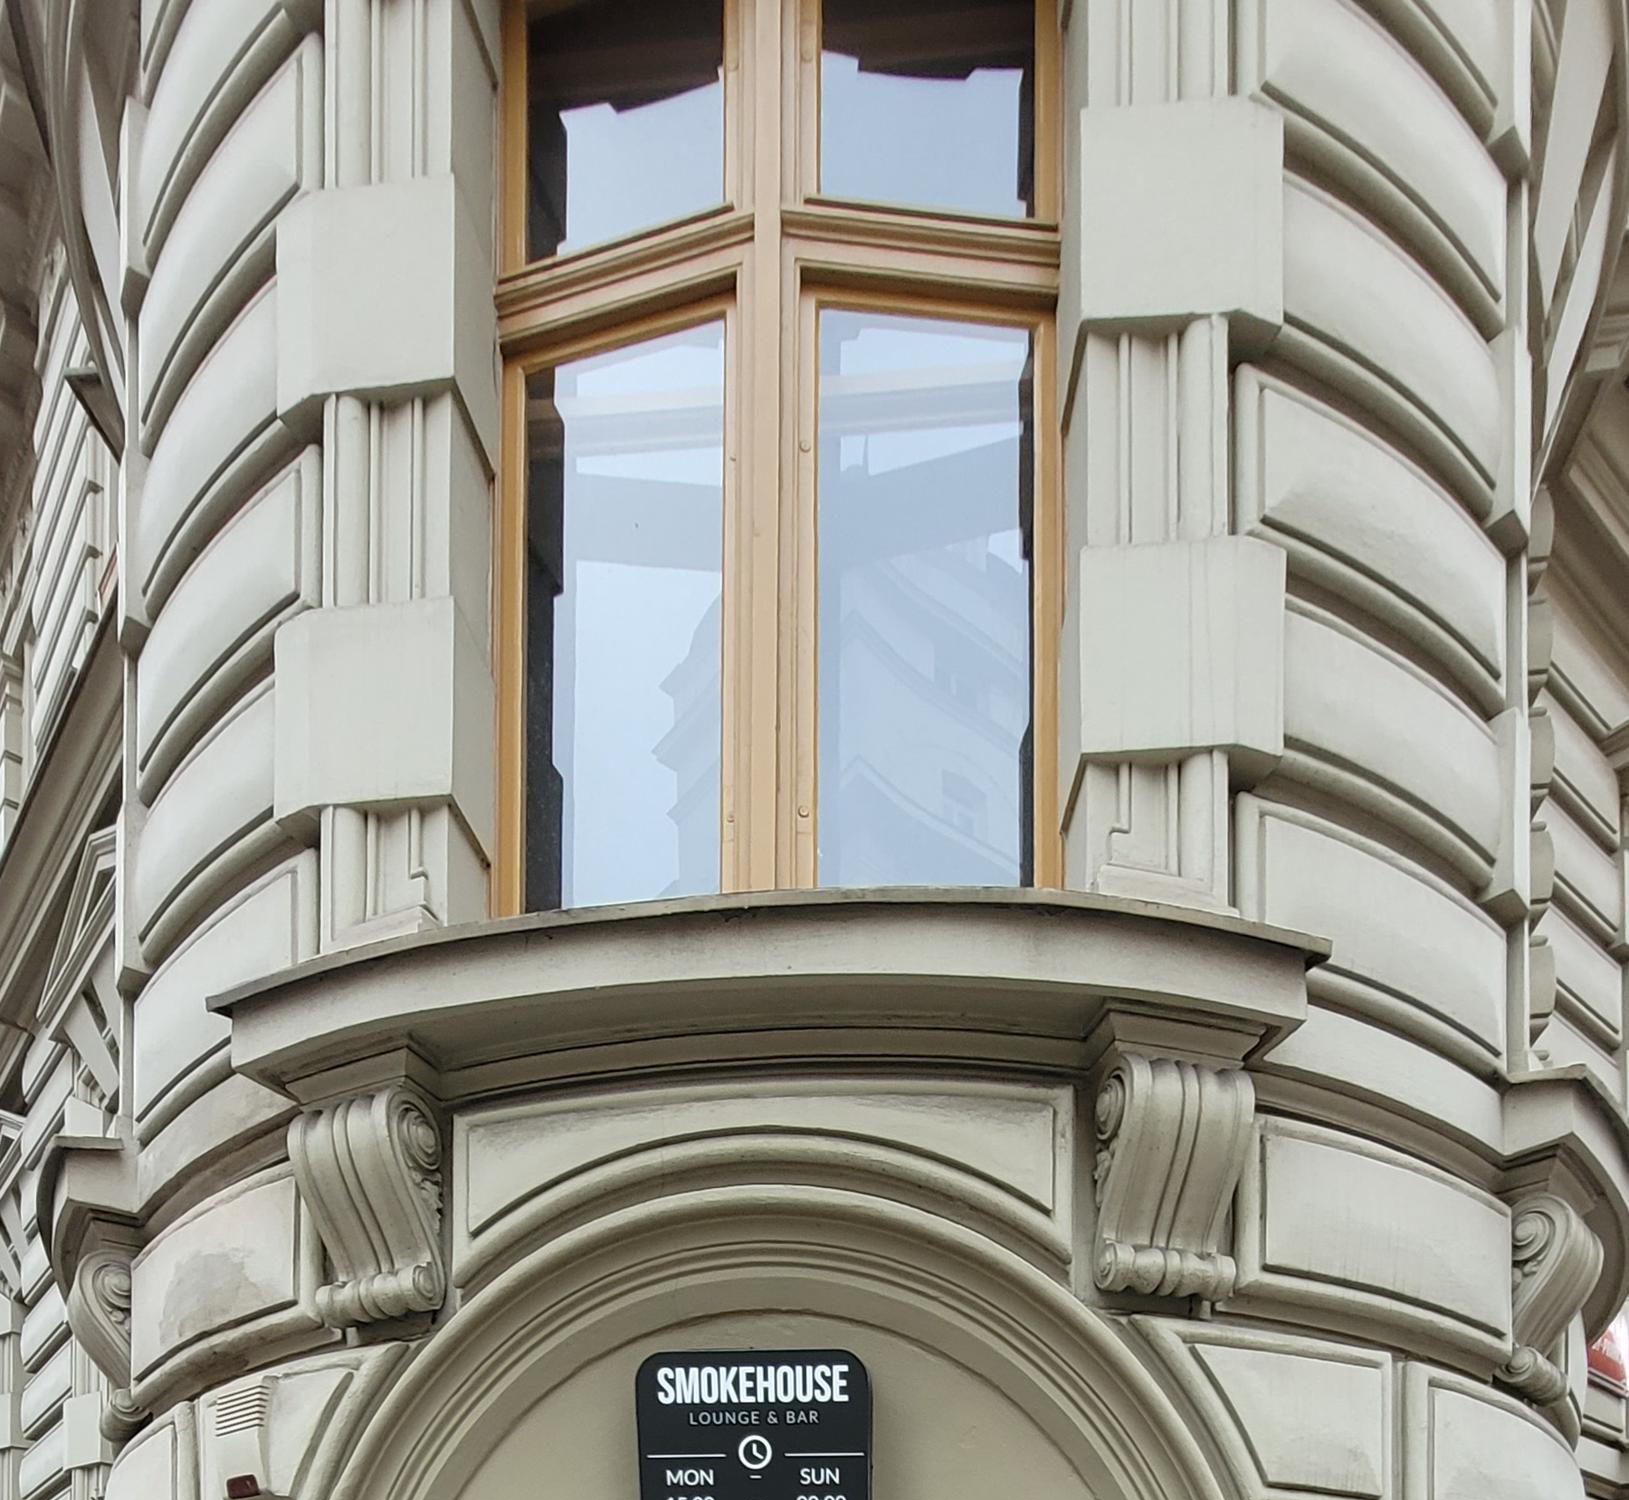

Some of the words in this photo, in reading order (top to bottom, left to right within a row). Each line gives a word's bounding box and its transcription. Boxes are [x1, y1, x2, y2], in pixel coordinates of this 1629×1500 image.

[657, 1365, 849, 1405] SMOKEHOUSE
[689, 1411, 760, 1425] LOUNGE
[767, 1412, 778, 1423] &
[786, 1411, 819, 1423] BAR
[666, 1470, 714, 1485] MON
[800, 1468, 840, 1484] SUN
